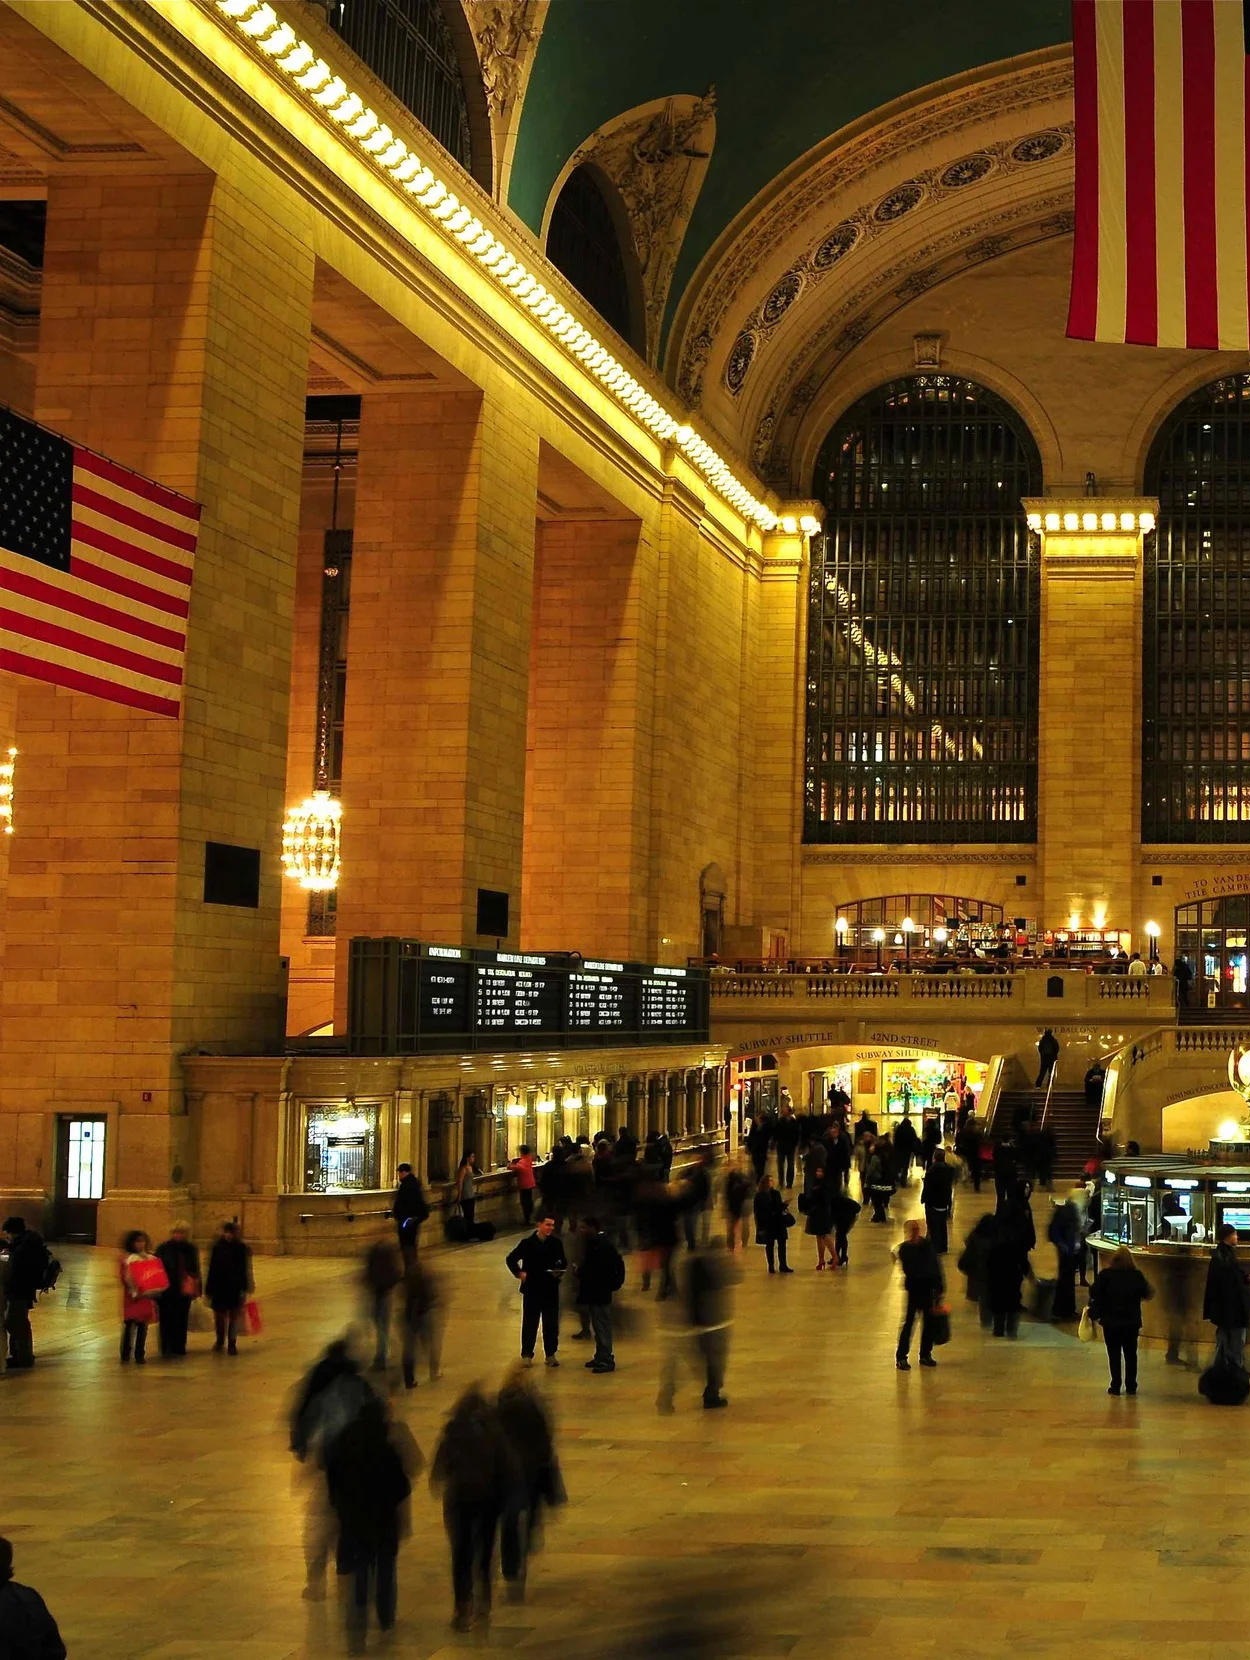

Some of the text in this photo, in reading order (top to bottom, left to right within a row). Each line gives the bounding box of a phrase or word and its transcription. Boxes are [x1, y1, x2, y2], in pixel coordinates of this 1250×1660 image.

[1192, 879, 1208, 889] TO
[1185, 888, 1207, 900] THE
[1060, 1026, 1098, 1034] BALCONY
[738, 1031, 833, 1053] SUBWAY SHUTTLE
[870, 1032, 940, 1048] 42ND STREET
[855, 1049, 894, 1061] SUBWAY
[1166, 1081, 1231, 1102] DINING CONCOUR
